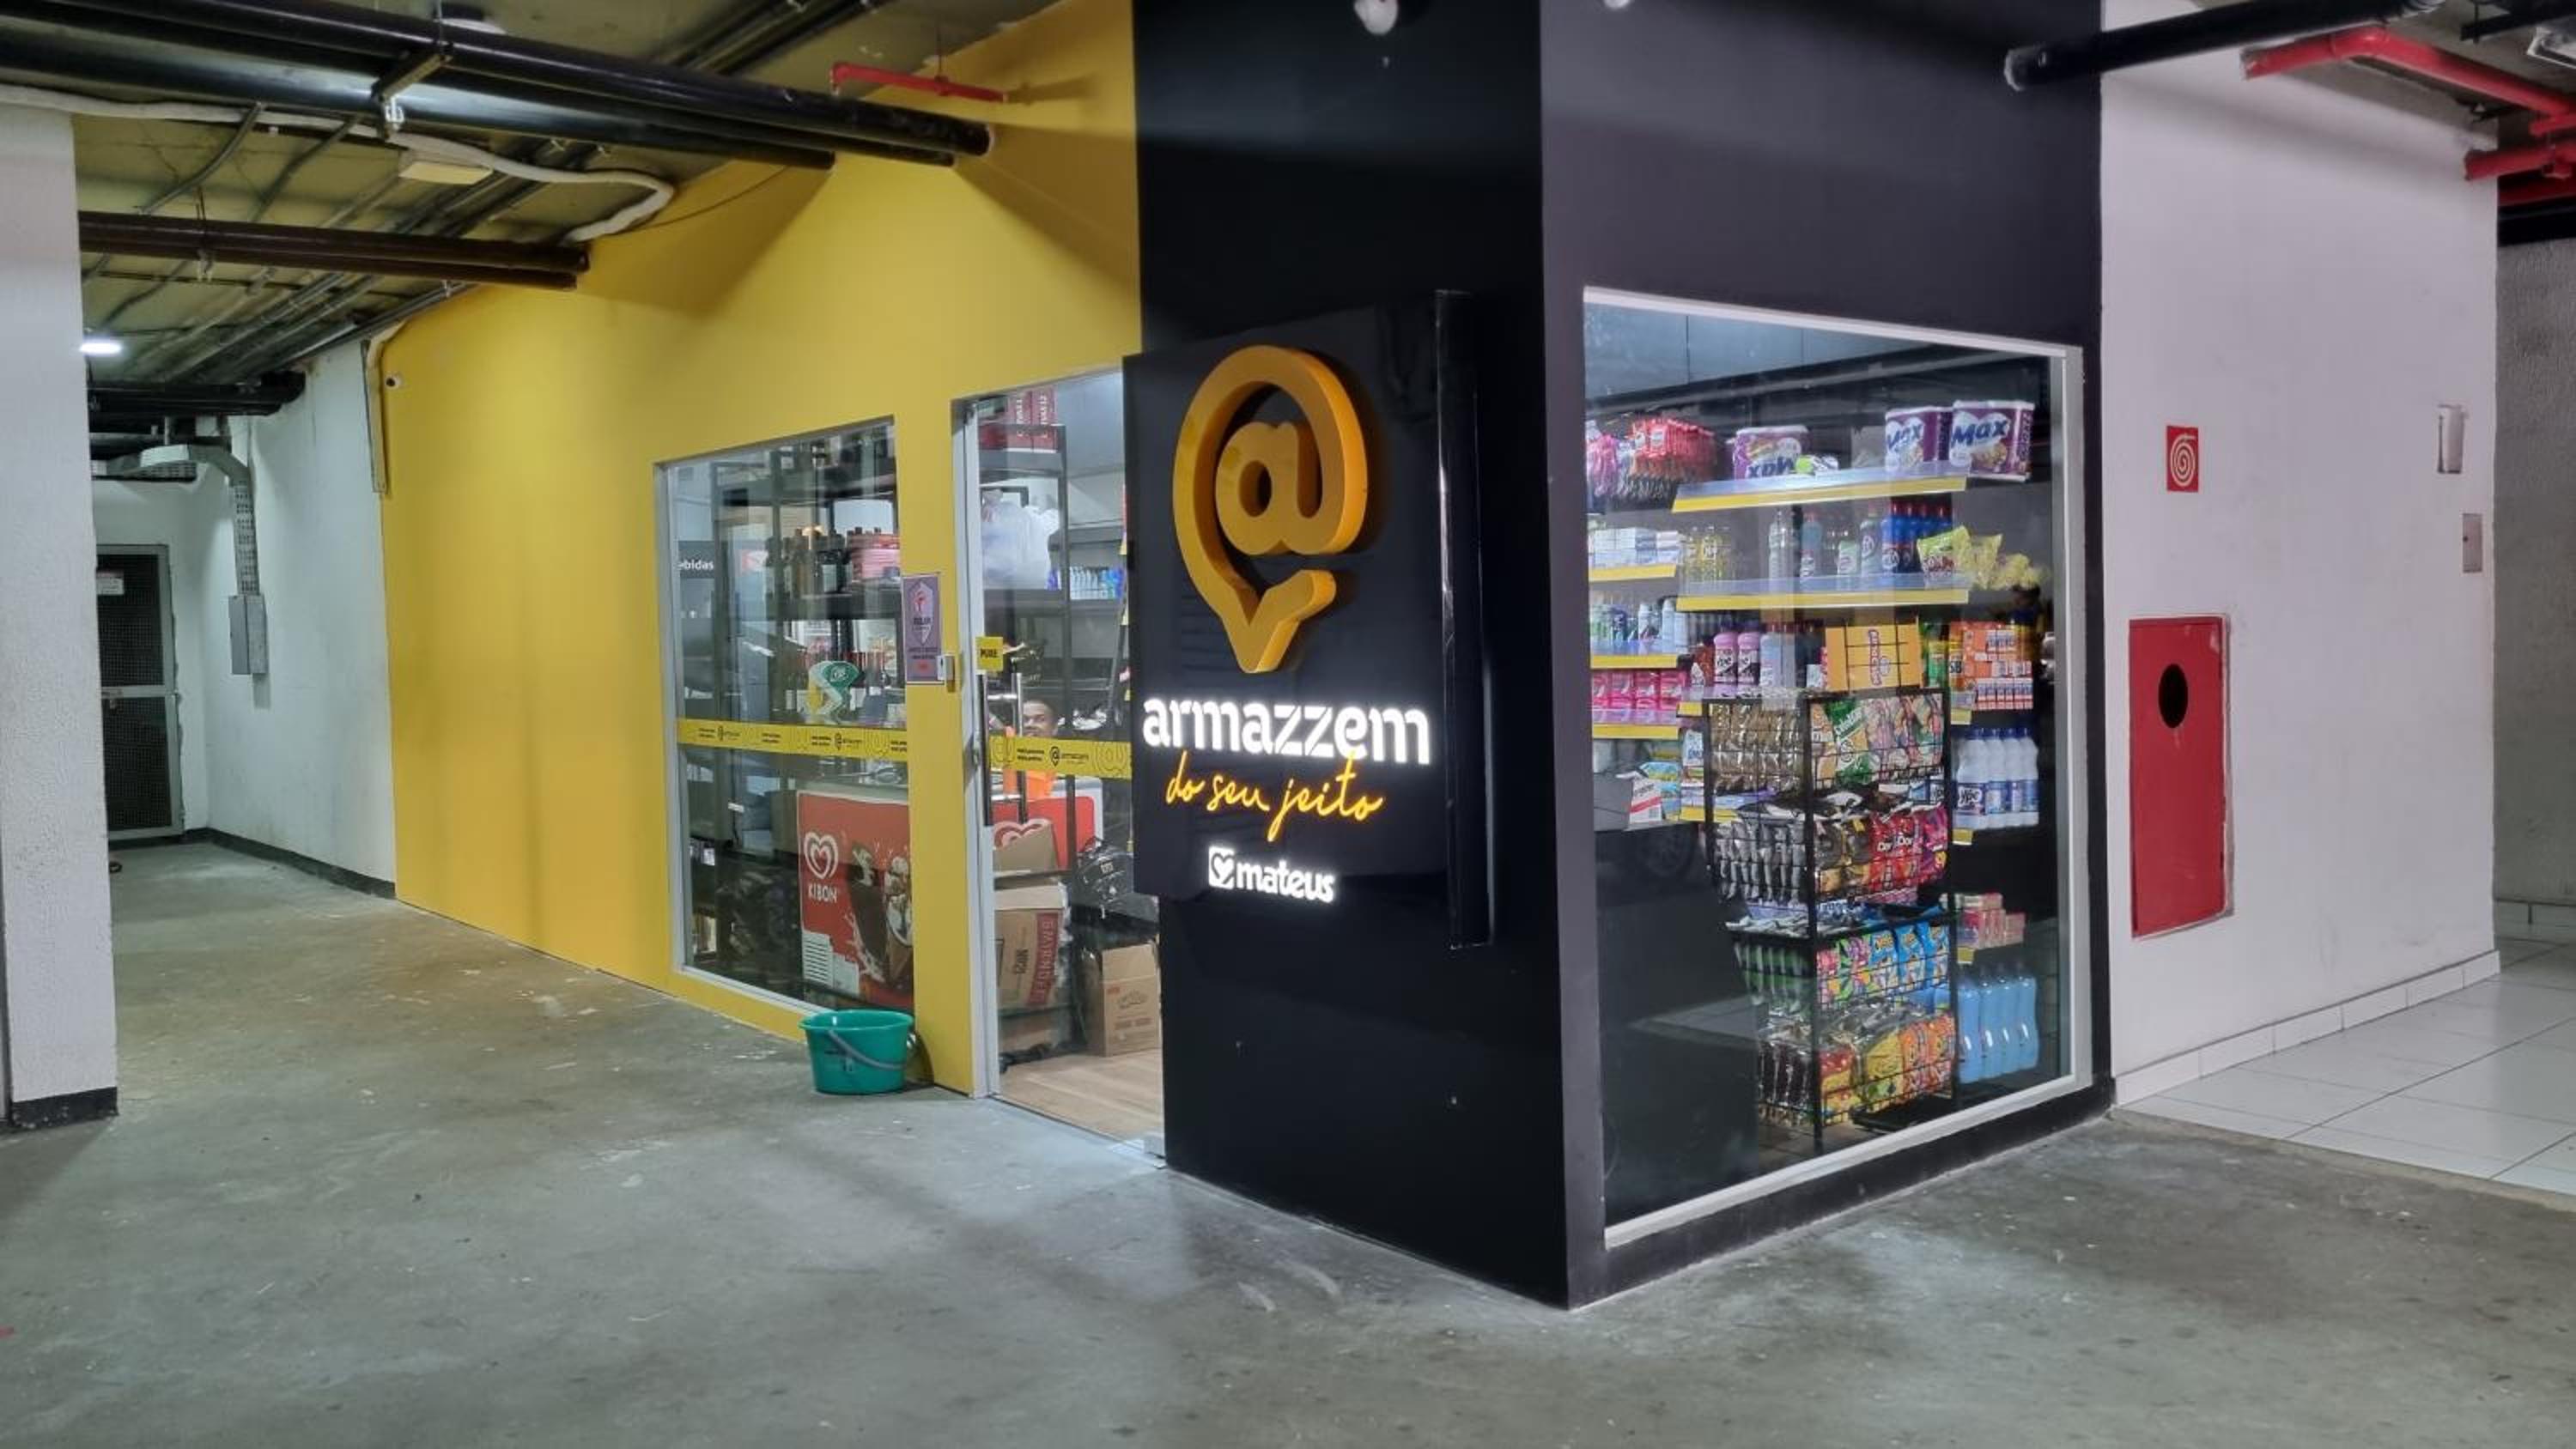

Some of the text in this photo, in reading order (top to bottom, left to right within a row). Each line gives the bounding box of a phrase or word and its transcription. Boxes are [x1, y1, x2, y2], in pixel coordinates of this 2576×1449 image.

[1950, 420, 2008, 447] Max
[1143, 698, 1430, 764] armazzem
[1166, 749, 1384, 842] do seu jeito
[808, 882, 838, 904] KIBON
[1236, 860, 1336, 903] mateus
